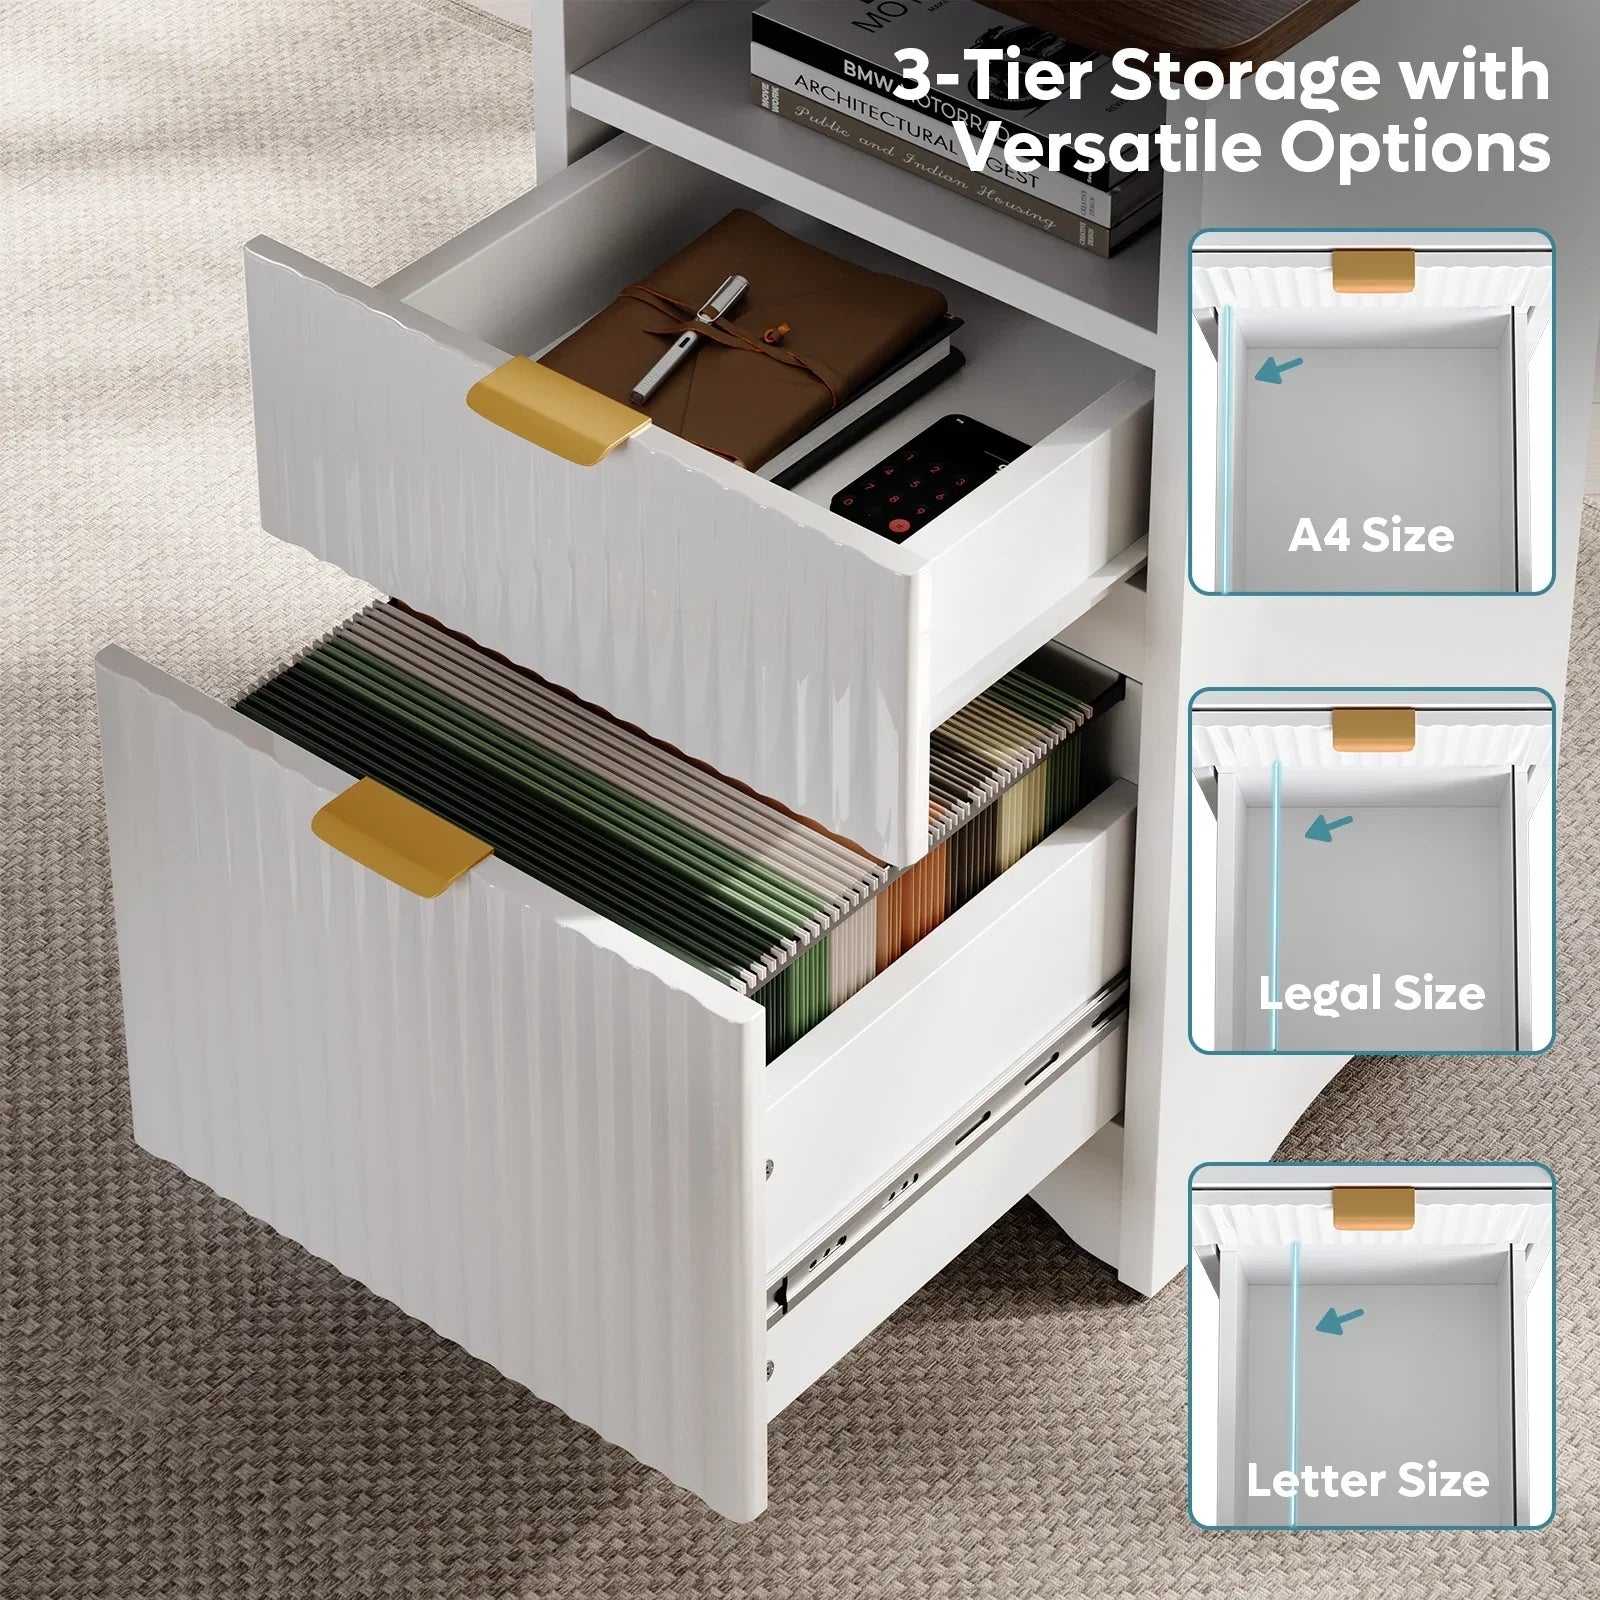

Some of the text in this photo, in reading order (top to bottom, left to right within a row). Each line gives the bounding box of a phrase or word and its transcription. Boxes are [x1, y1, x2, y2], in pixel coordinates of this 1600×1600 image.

[761, 82, 769, 108] MOVE
[771, 86, 779, 113] WORK
[794, 75, 958, 155] ARCHITECTURAL
[975, 152, 1040, 189] GEST
[844, 59, 1010, 142] BMW OTORRAD
[794, 105, 1056, 231] Public and Indian Housing
